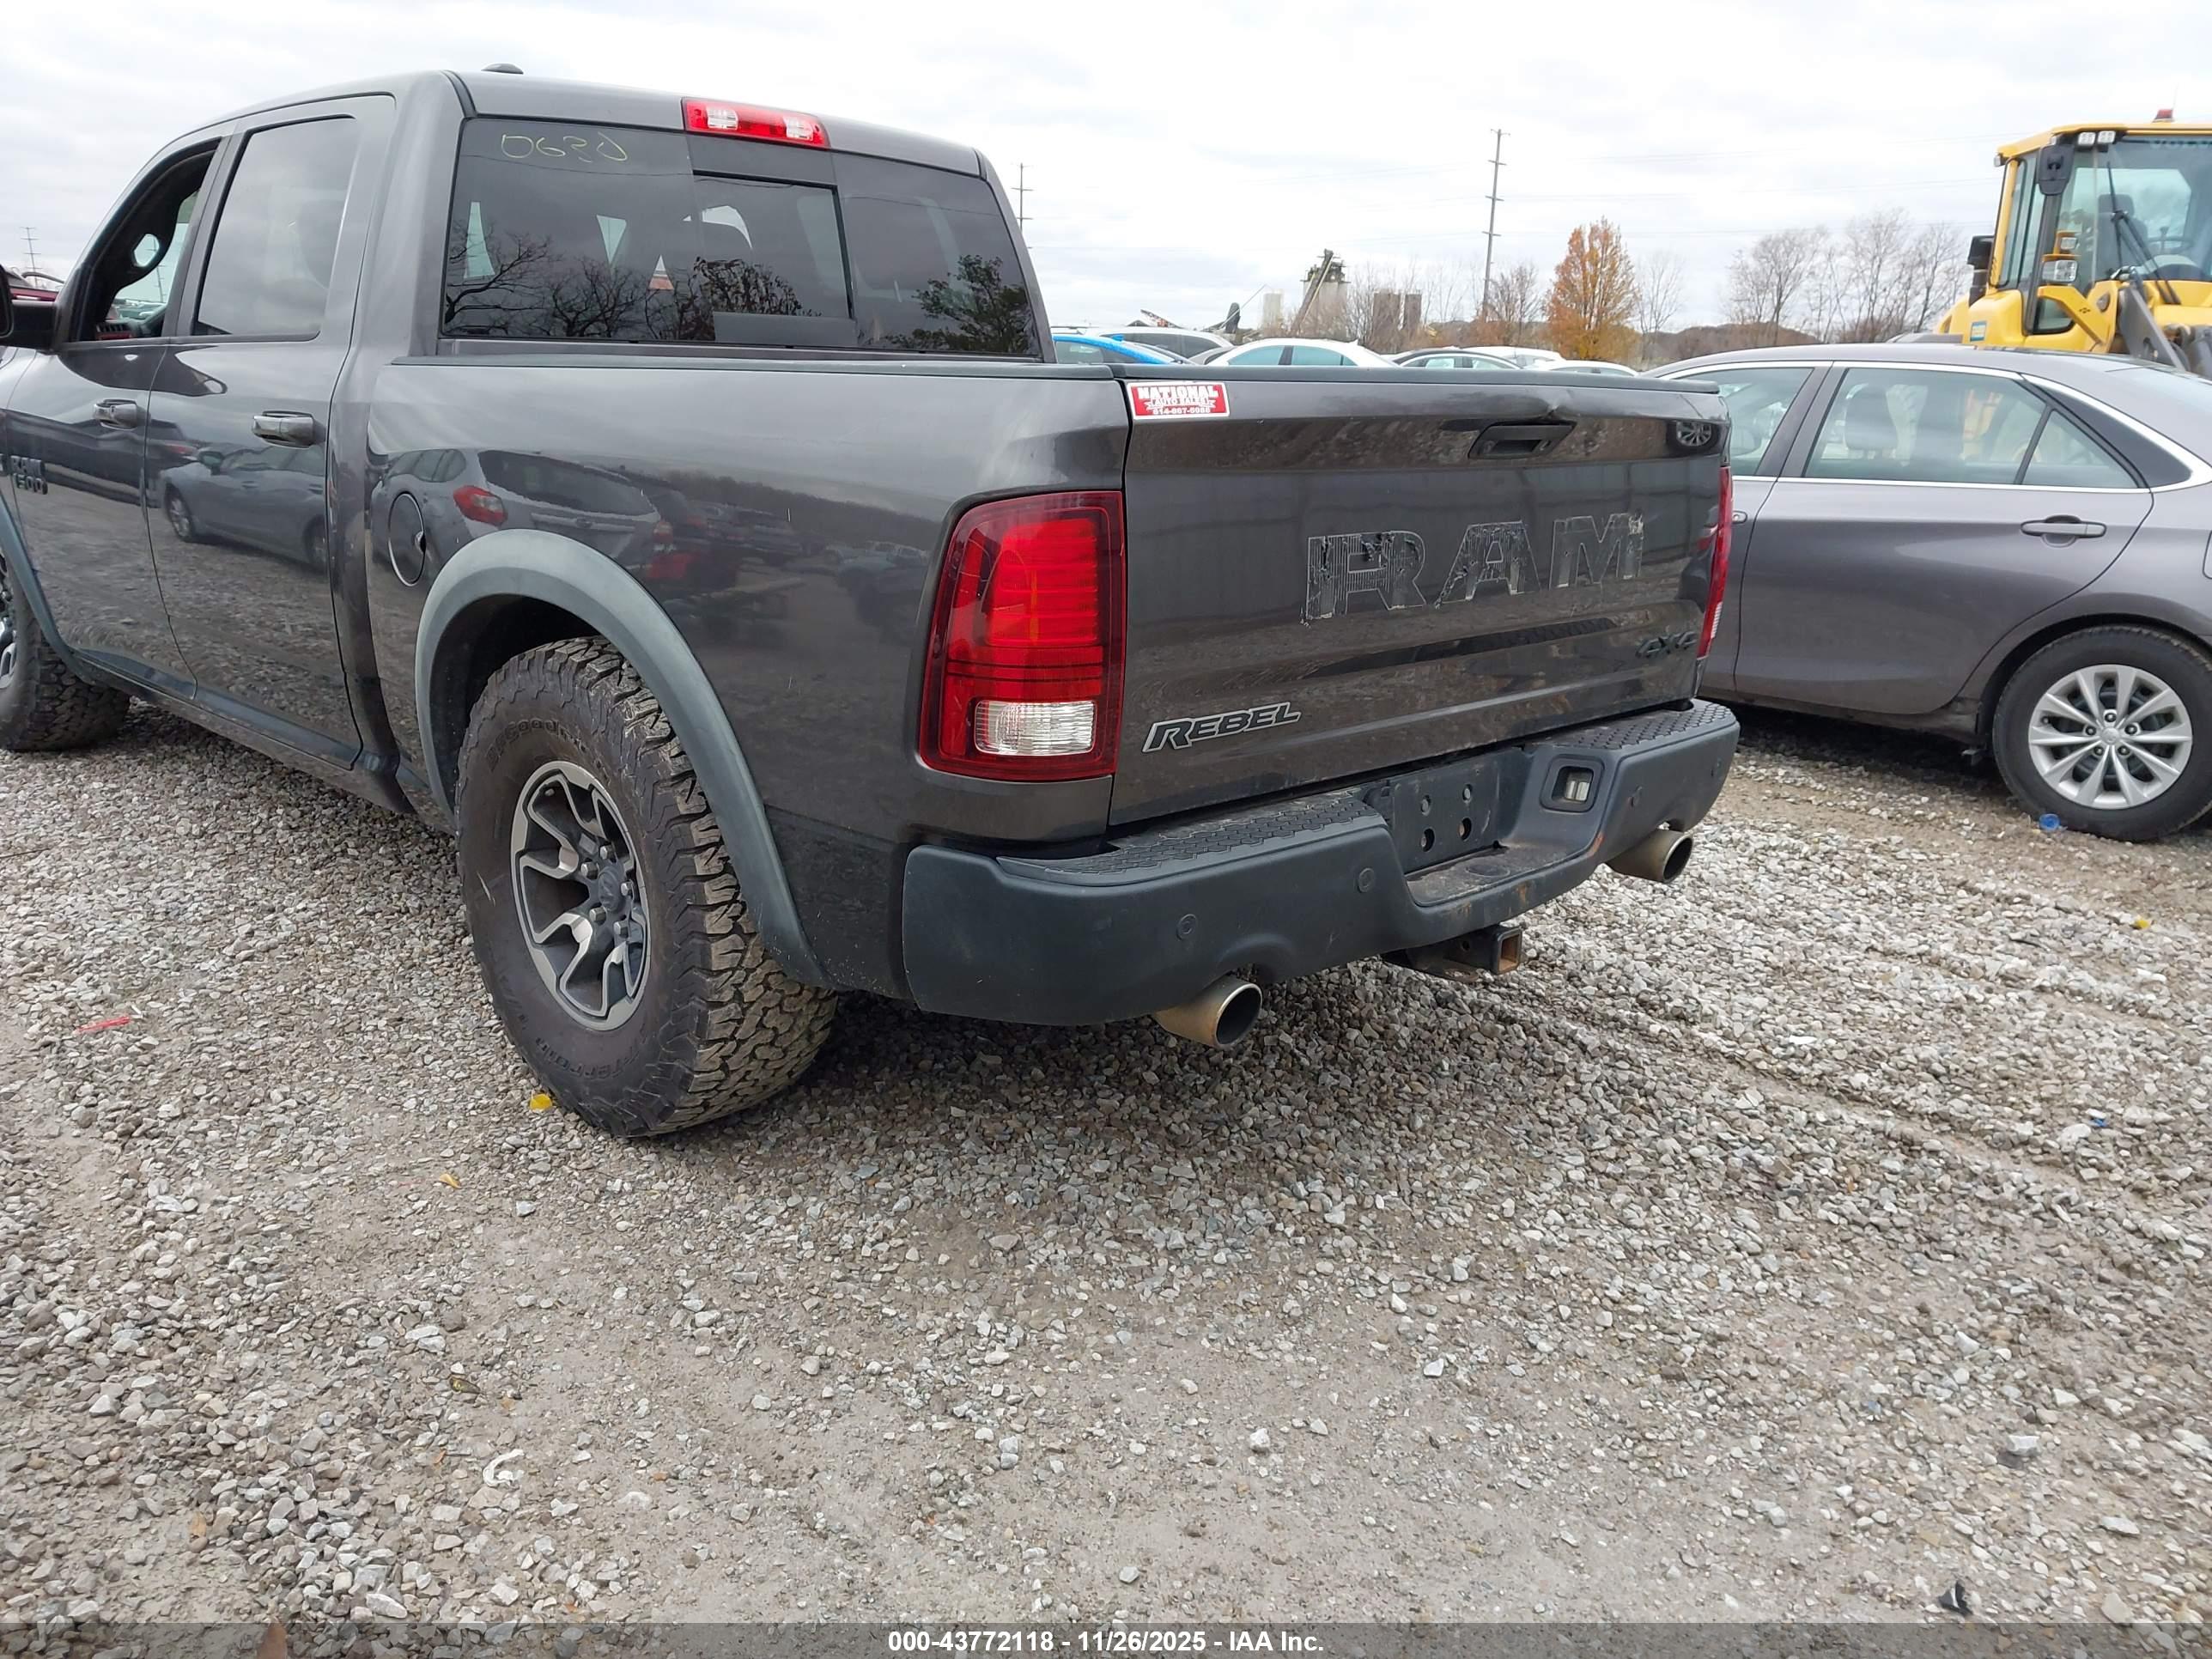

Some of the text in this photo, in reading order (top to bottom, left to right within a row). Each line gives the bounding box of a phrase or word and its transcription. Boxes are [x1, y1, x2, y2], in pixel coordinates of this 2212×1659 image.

[1137, 385, 1218, 399] NATIONAL
[1154, 398, 1177, 406] AUTO
[1305, 513, 1644, 620] RAM
[1142, 702, 1301, 752] REBEL
